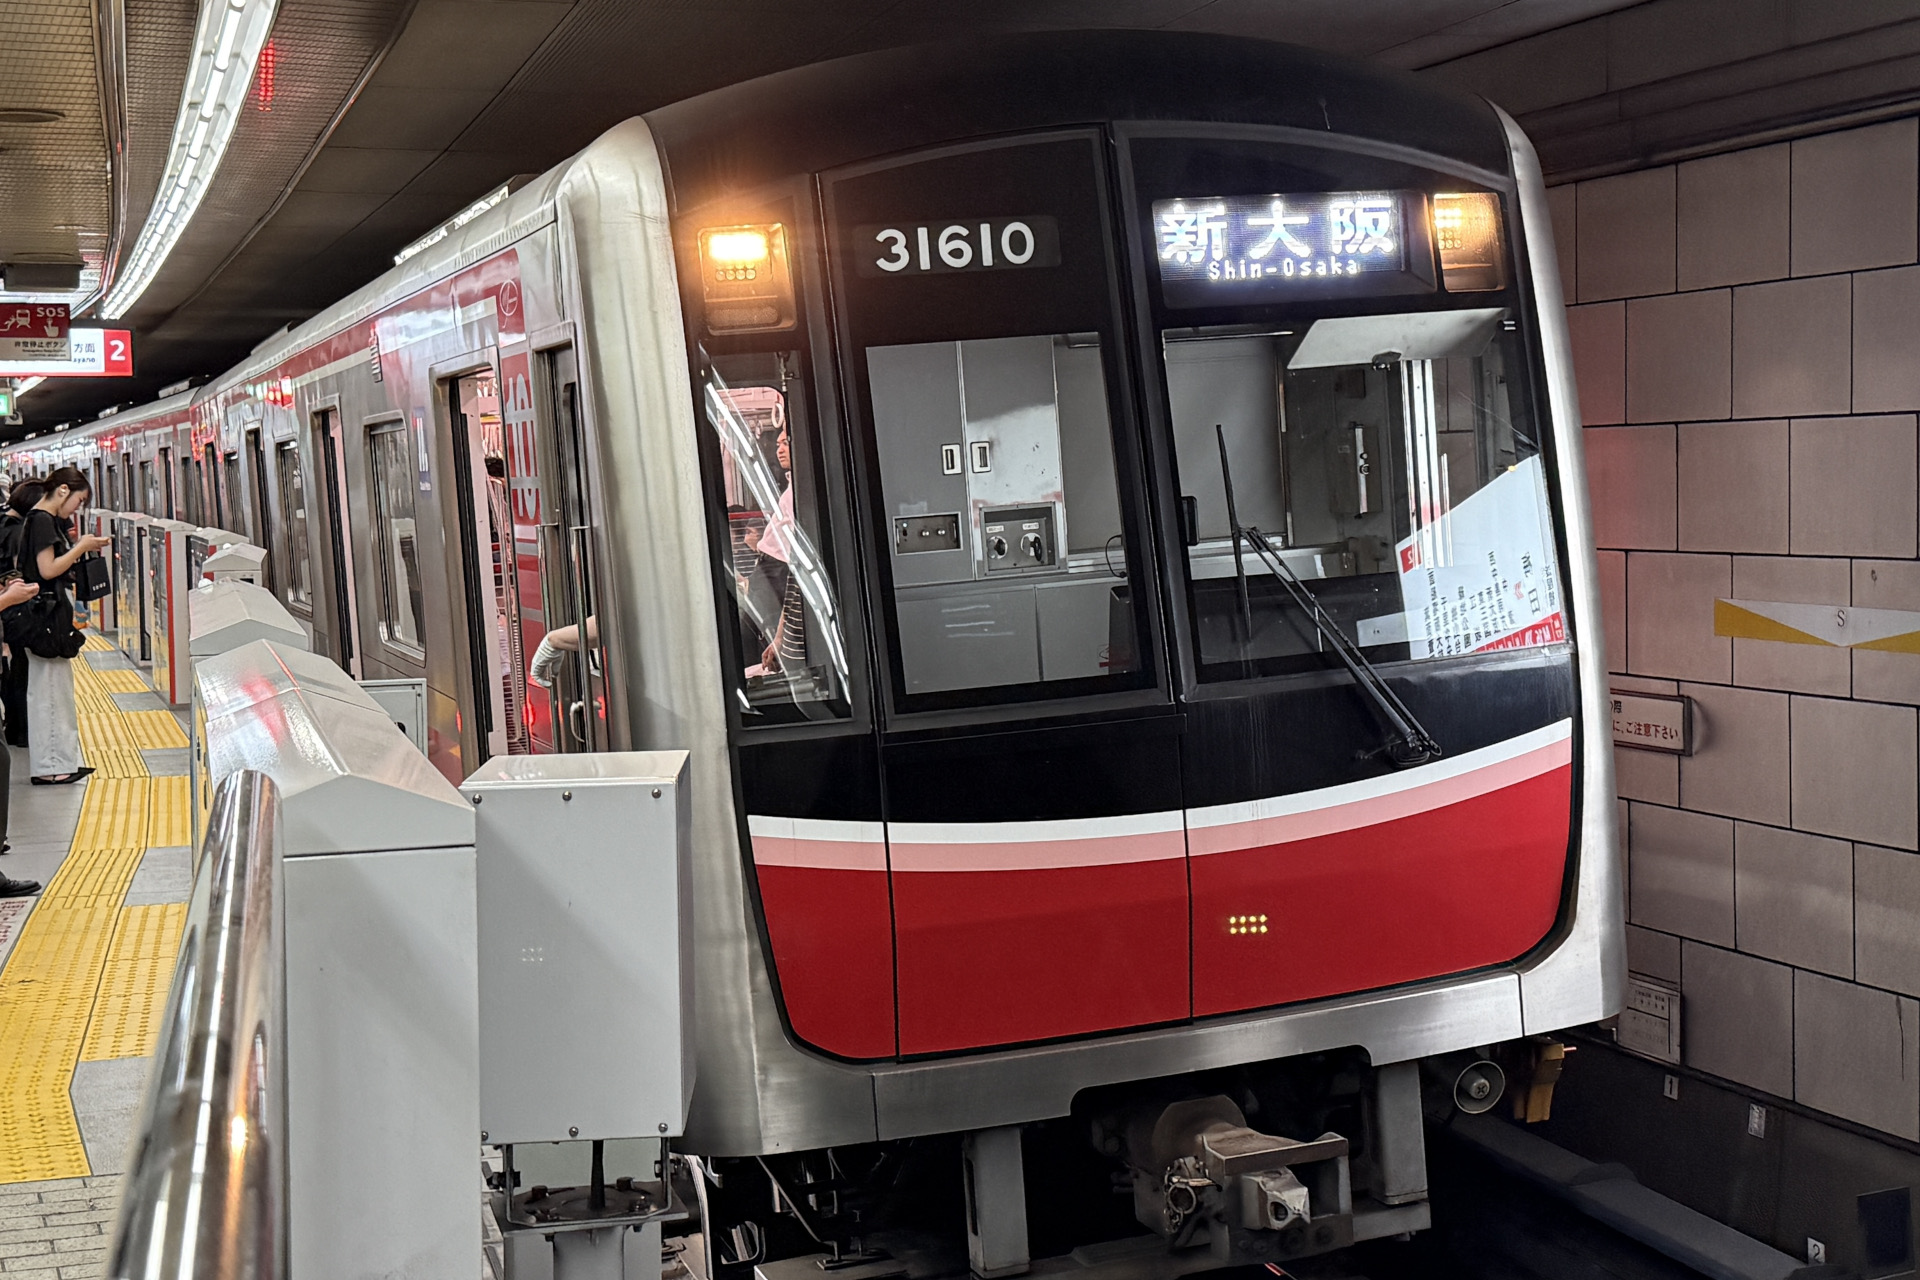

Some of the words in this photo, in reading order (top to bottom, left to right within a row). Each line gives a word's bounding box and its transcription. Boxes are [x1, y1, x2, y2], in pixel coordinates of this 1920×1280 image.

[1161, 200, 1394, 263] 新大阪
[875, 221, 1035, 272] 31610
[1208, 256, 1359, 280] Shin-Osaka
[37, 307, 66, 318] SOS
[73, 343, 96, 354] 方面
[109, 339, 126, 362] 2
[1837, 609, 1845, 628] S
